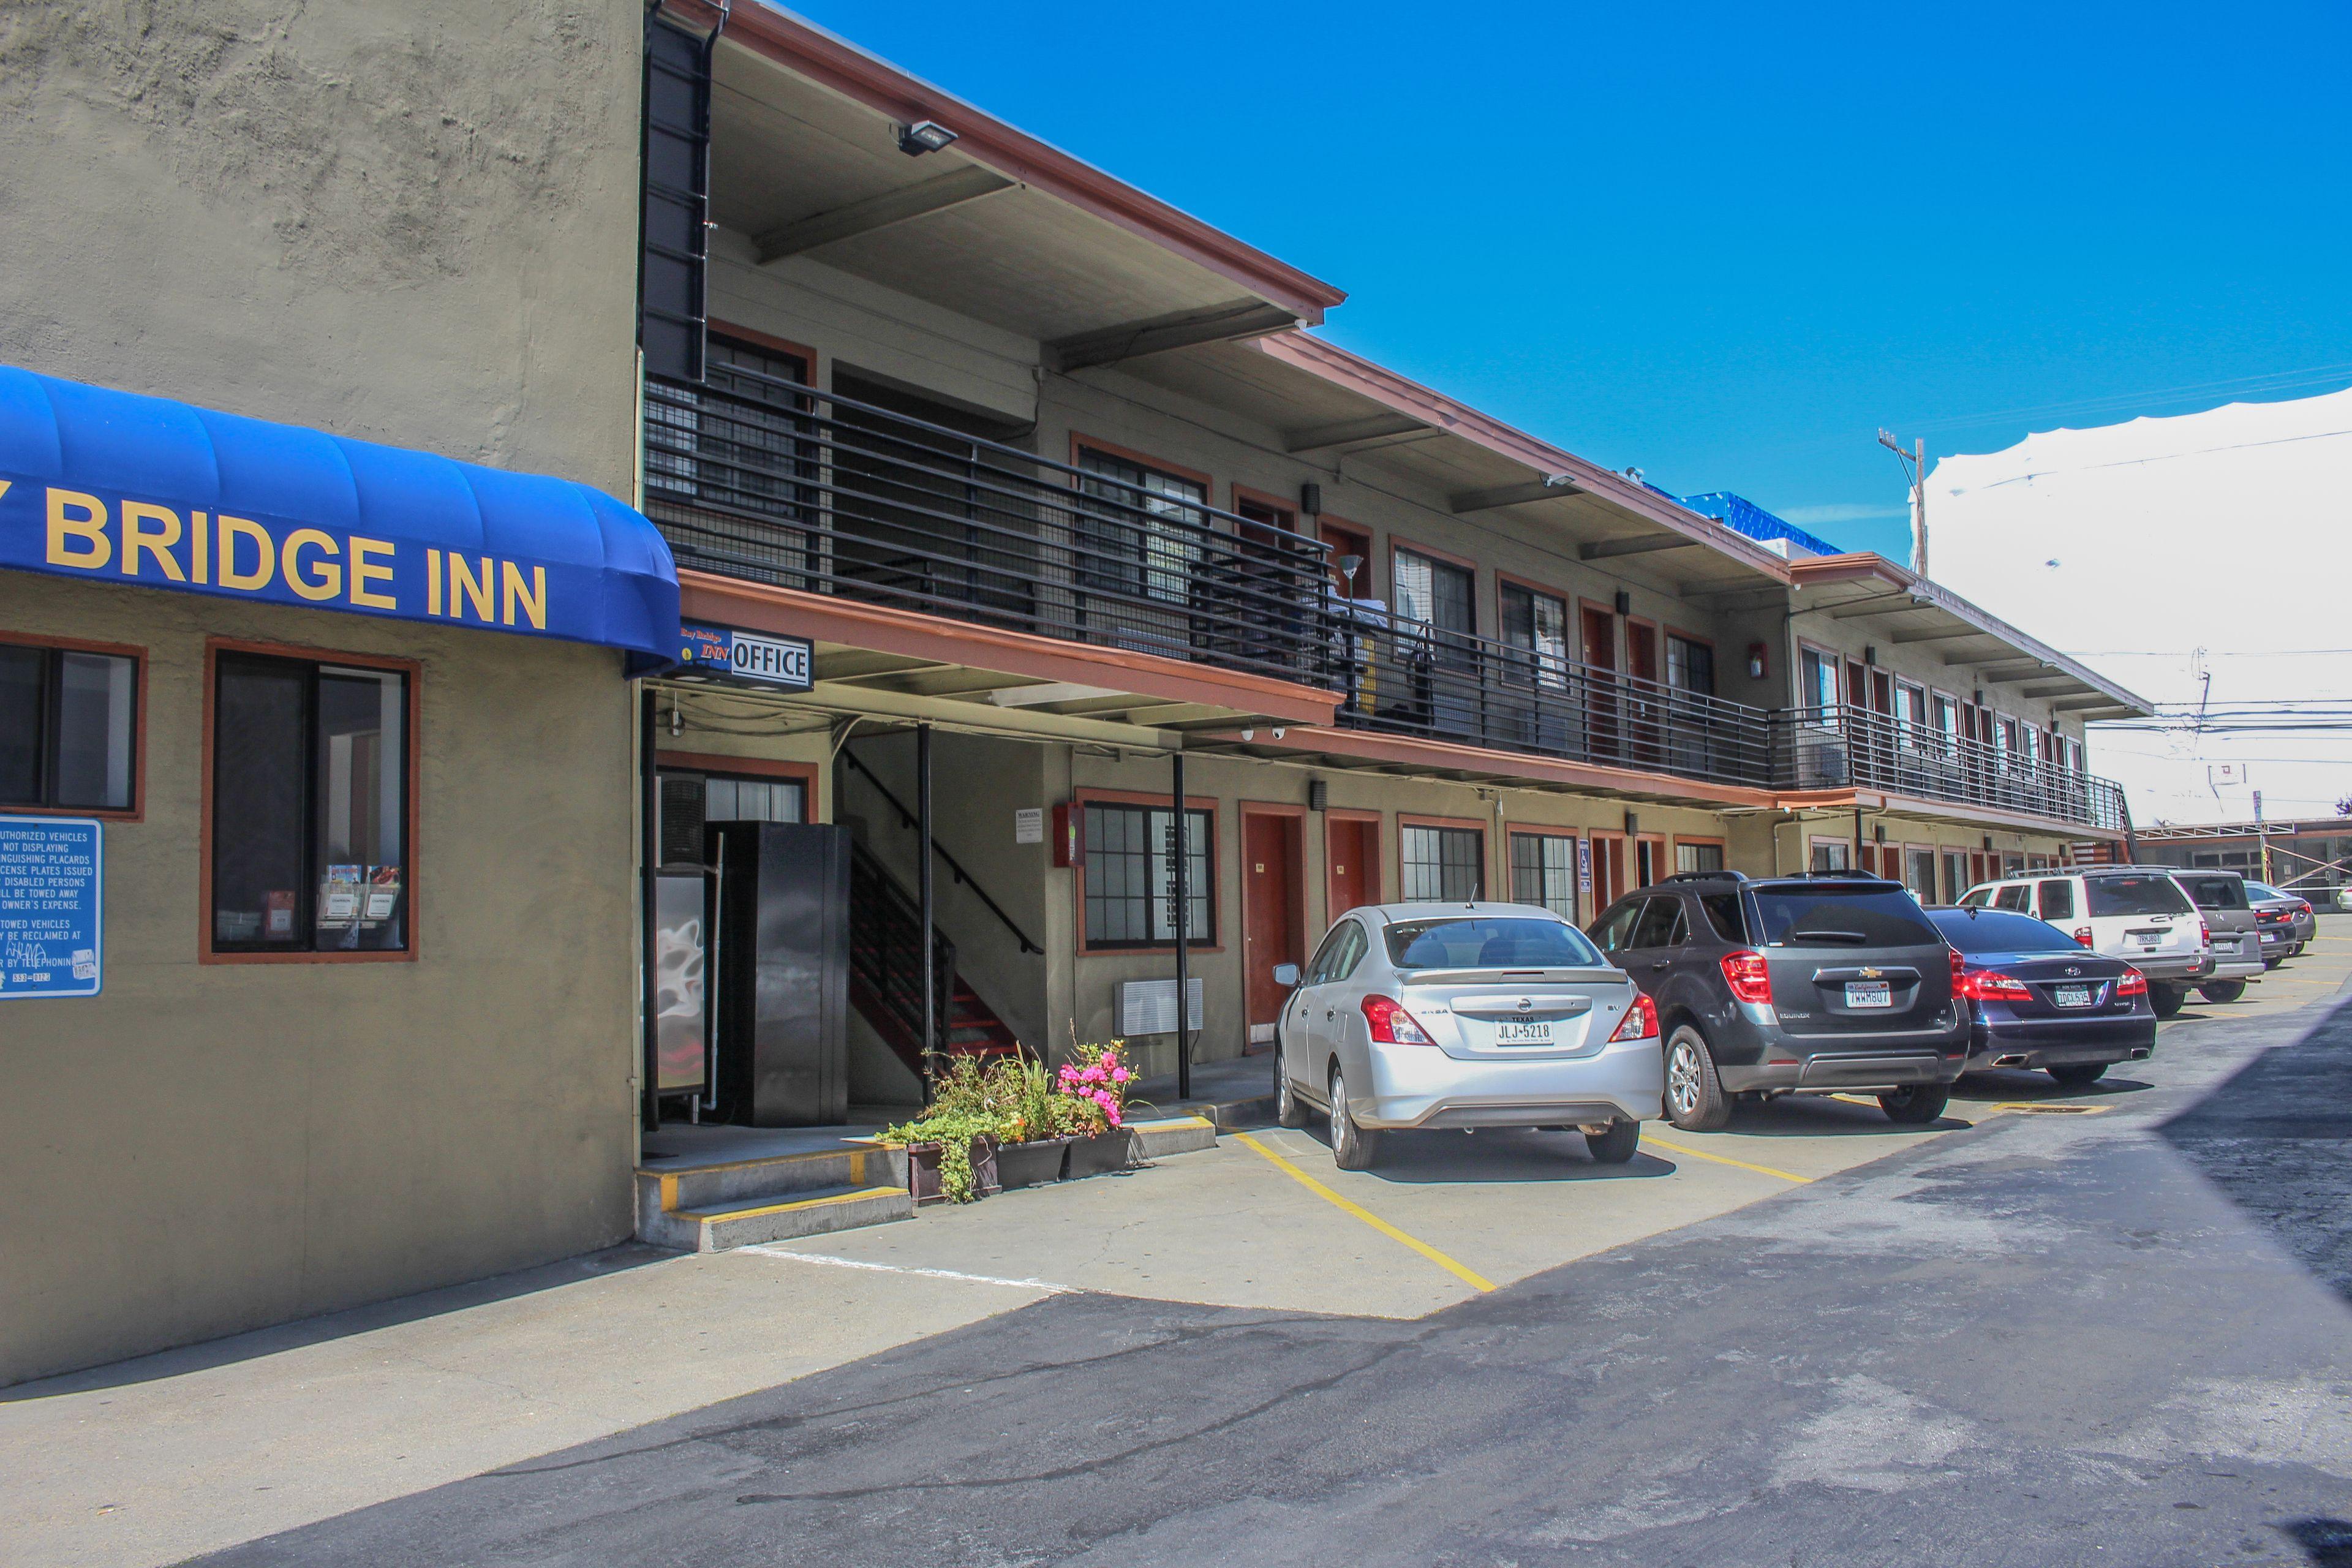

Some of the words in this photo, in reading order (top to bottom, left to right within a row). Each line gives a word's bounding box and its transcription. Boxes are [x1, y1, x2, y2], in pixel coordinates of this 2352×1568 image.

[46, 488, 397, 610] BRIDGE
[428, 548, 546, 630] INN
[701, 644, 729, 661] INN
[734, 643, 806, 677] OFFICE
[49, 832, 88, 842] VEHICLES
[3, 842, 19, 851] NOT
[23, 843, 69, 853] DISPLAYING
[49, 855, 89, 864] PLACARDS
[0, 865, 27, 875] CENSE
[31, 866, 60, 875] PLATES
[64, 866, 92, 876] ISSUED
[5, 877, 44, 886] DISABLED
[48, 878, 85, 887] PERSONS
[14, 889, 25, 898] BE
[29, 889, 56, 898] TOWED
[59, 889, 78, 898] AWAY
[2, 900, 39, 910] OWNER'S
[42, 900, 81, 910] EXPENSE.
[1, 919, 28, 929] TOWED
[31, 919, 70, 929] VEHICLES
[8, 931, 18, 940] BE
[23, 931, 69, 940] RECLAIMED
[72, 930, 81, 940] AT
[7, 959, 18, 968] BY
[1850, 990, 1887, 1003] 7WWM807
